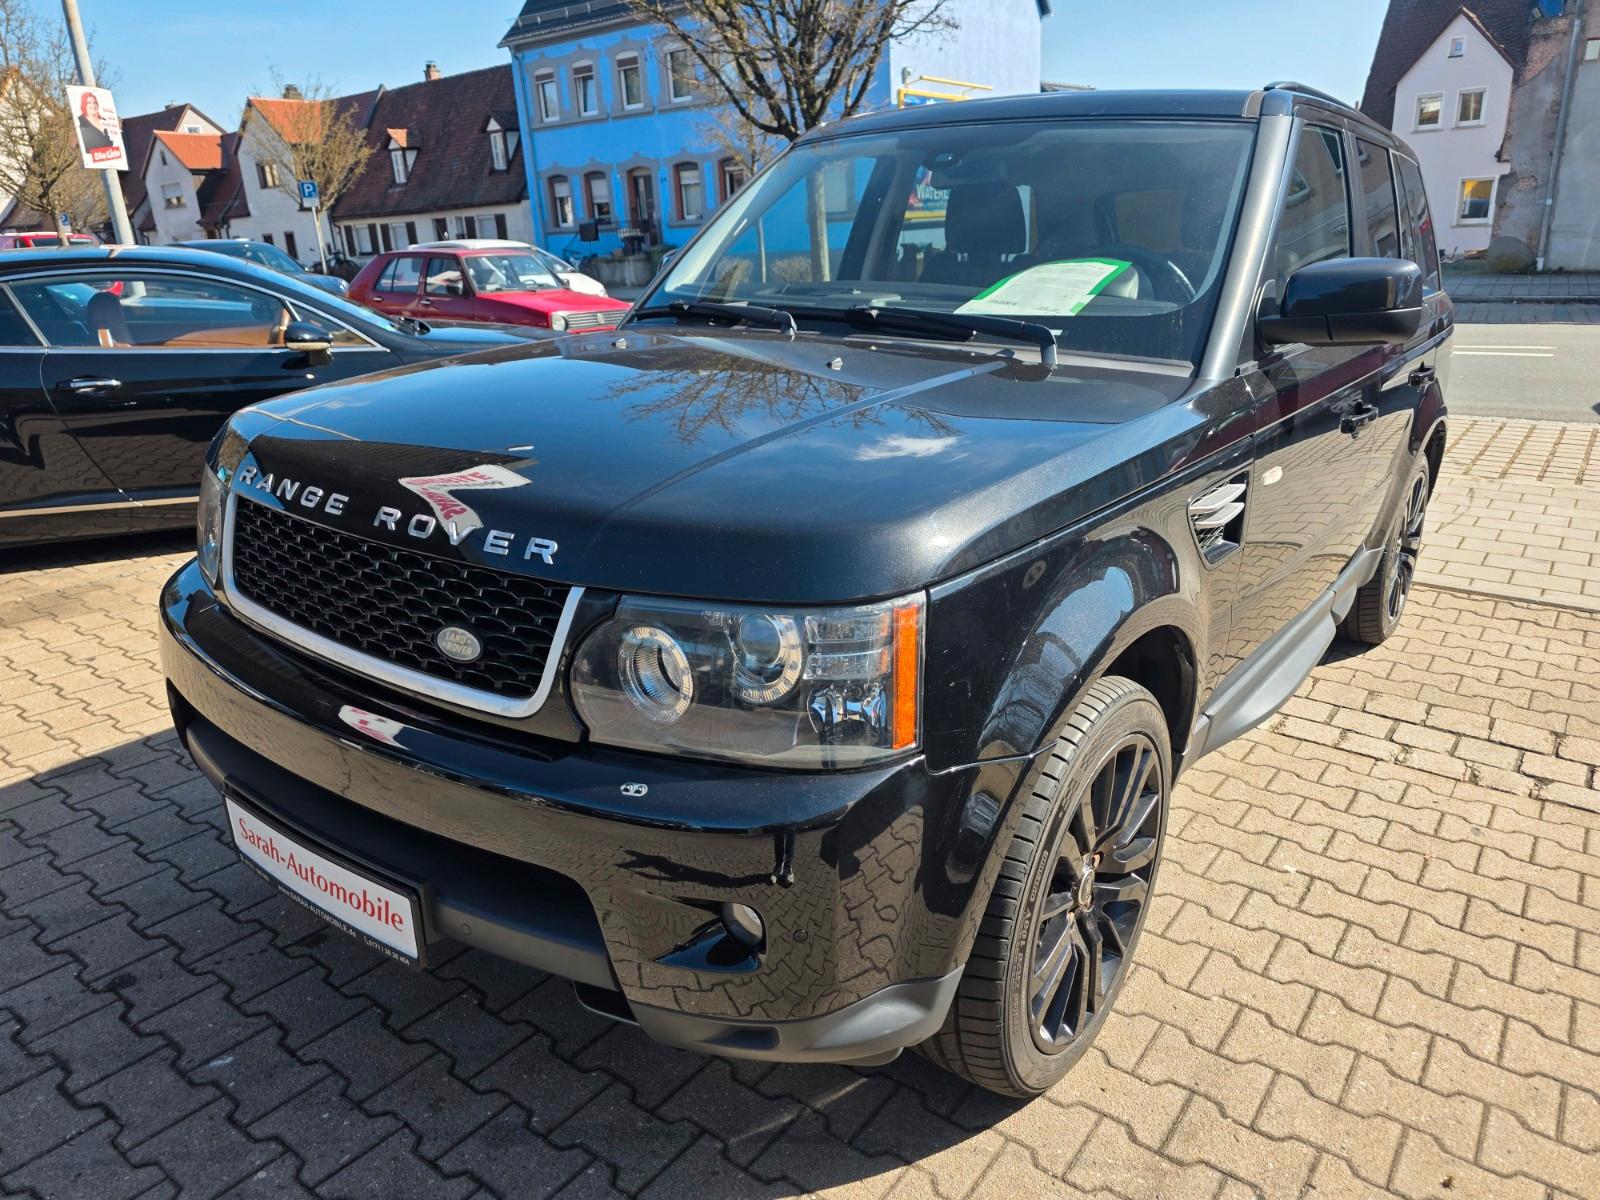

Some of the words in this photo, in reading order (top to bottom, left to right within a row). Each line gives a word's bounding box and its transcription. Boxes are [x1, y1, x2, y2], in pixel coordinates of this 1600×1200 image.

[303, 183, 314, 197] P
[239, 465, 350, 516] RANGE
[373, 505, 559, 565] ROVER
[445, 630, 466, 646] LAND
[238, 817, 404, 933] Sarah-Automobile
